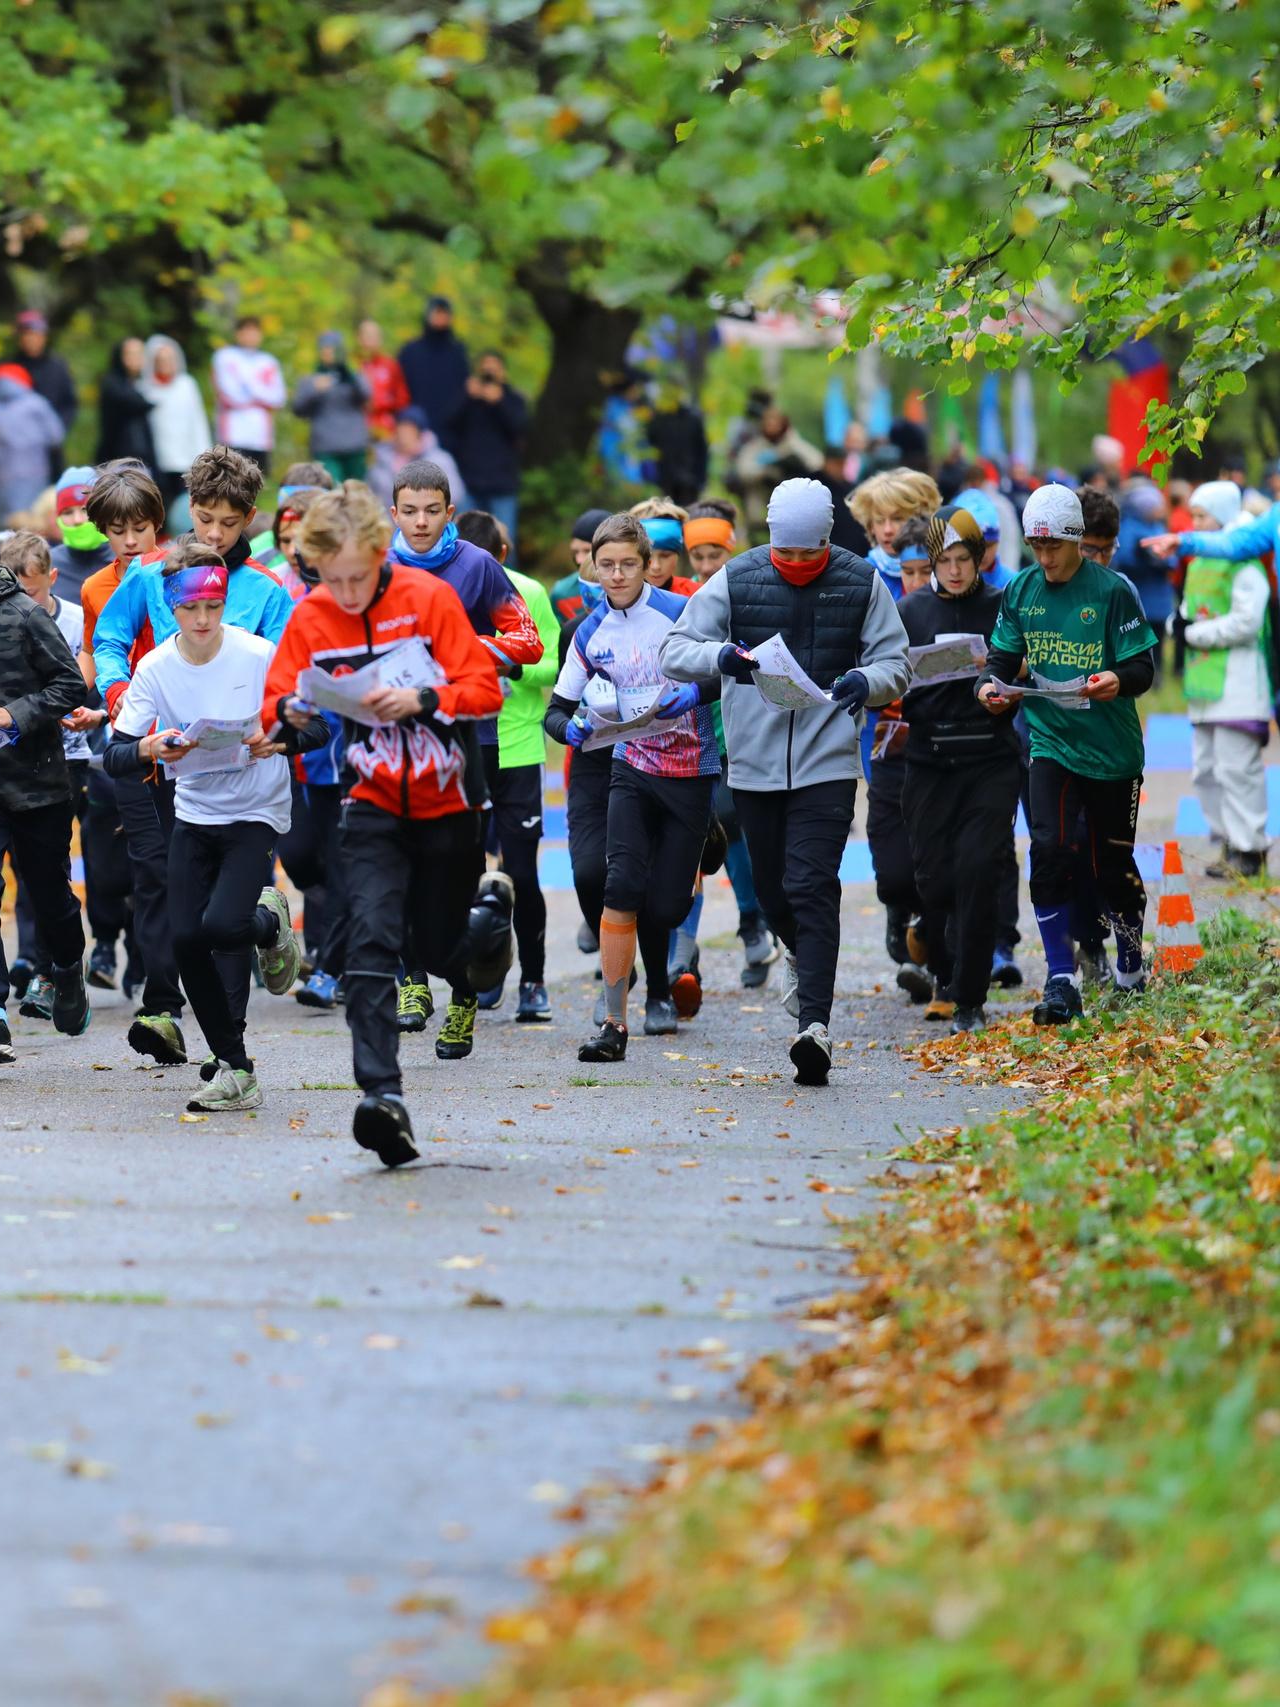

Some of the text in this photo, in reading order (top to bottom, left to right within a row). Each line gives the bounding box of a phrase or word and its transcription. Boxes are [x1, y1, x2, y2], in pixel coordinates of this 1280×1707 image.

[1043, 631, 1063, 640] БАНК
[1028, 652, 1103, 670] АРАФОН
[630, 706, 650, 719] 35
